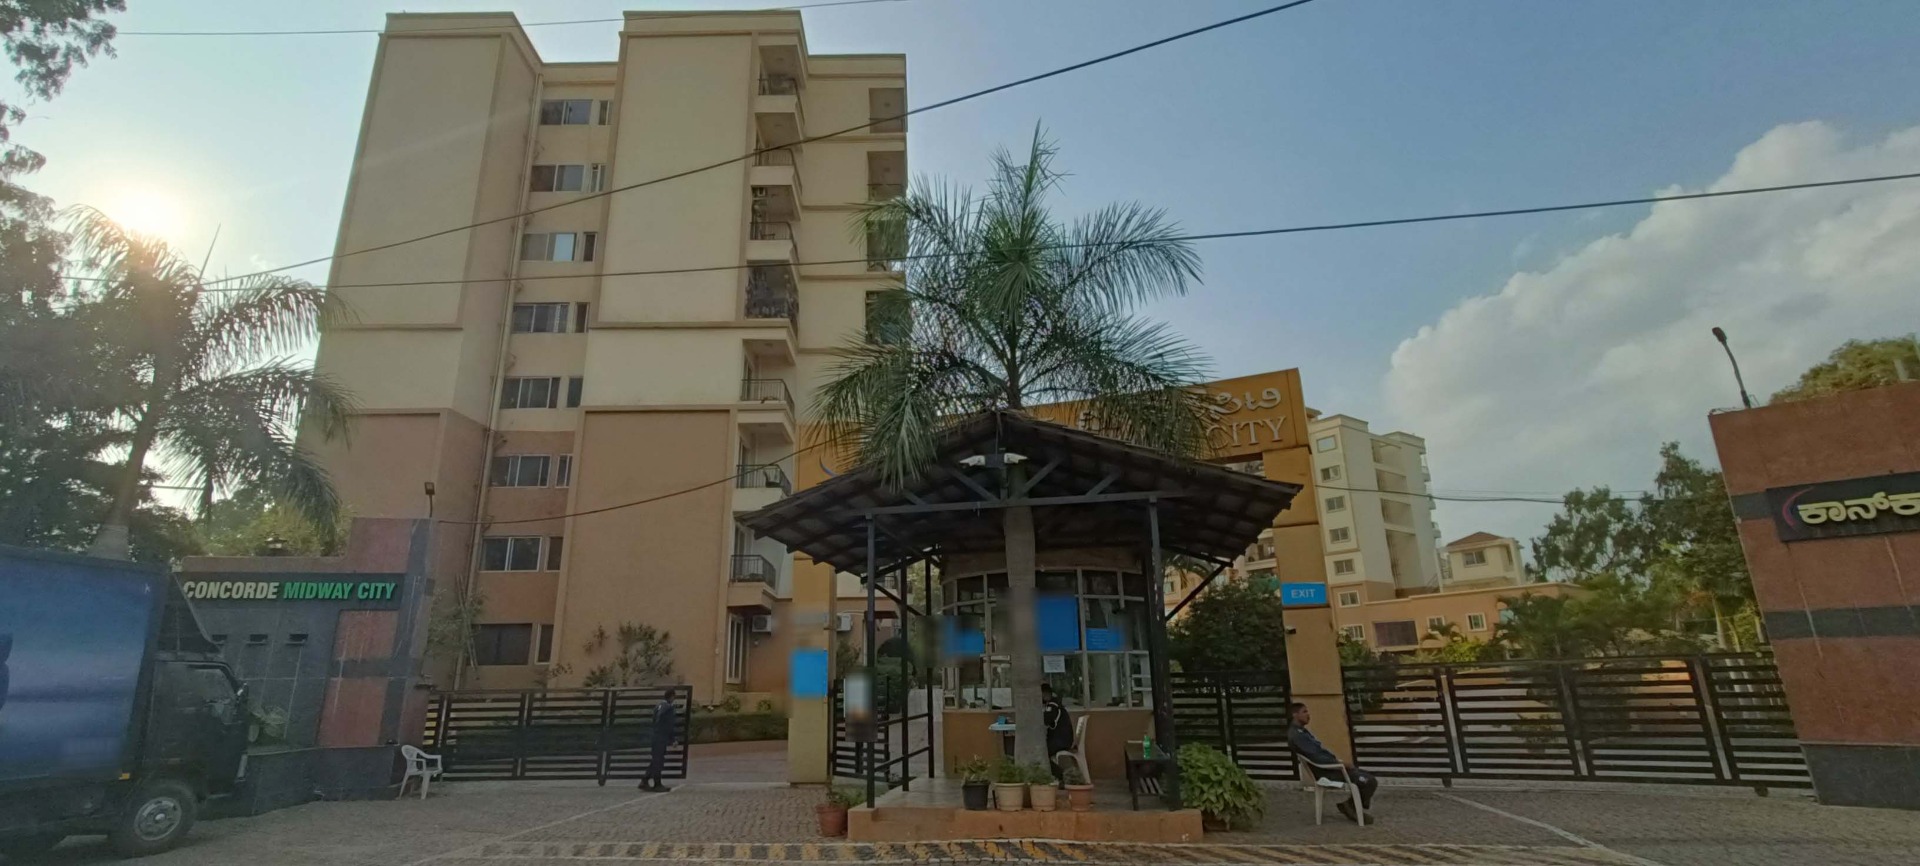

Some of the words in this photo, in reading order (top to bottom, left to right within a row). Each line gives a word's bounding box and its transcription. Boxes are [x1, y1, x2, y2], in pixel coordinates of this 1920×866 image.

[1206, 415, 1287, 449] CITY
[183, 581, 280, 600] CONCORDE
[283, 582, 353, 600] MIDWAY
[357, 582, 396, 600] CITY
[1291, 588, 1316, 599] EXIT
